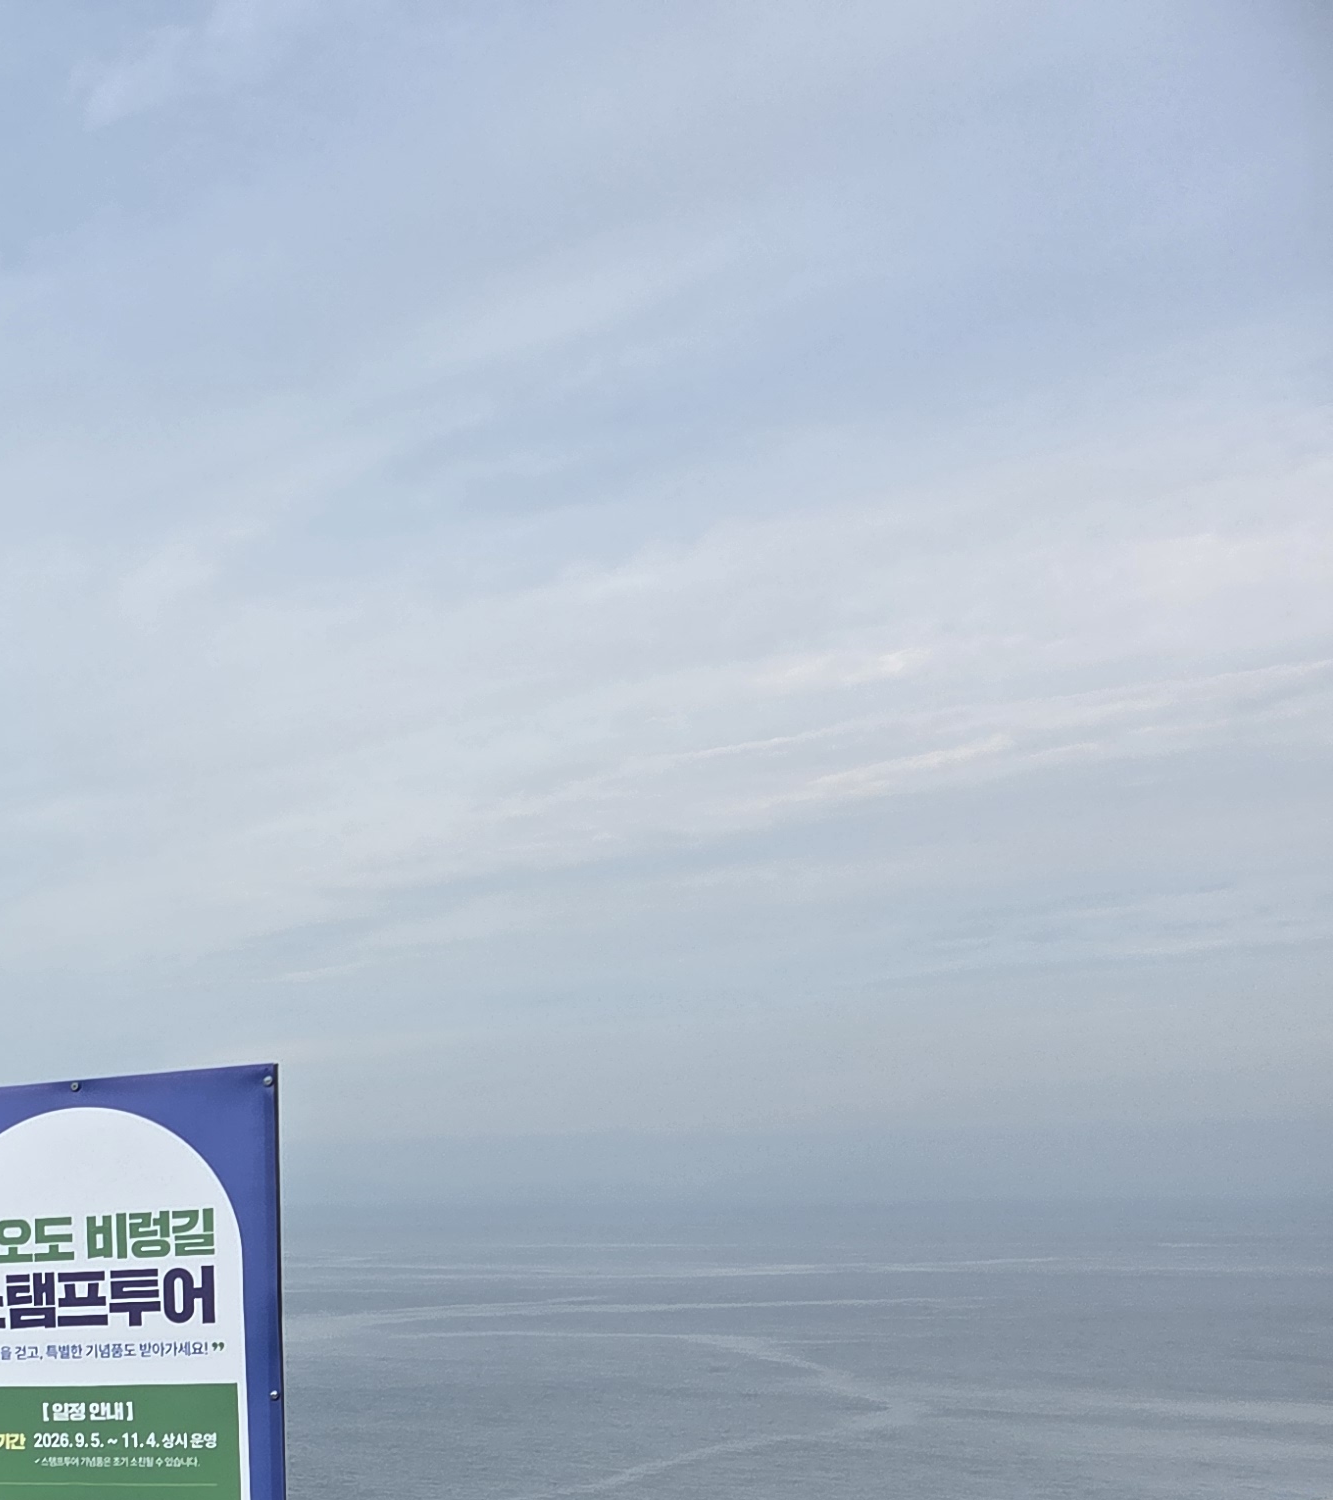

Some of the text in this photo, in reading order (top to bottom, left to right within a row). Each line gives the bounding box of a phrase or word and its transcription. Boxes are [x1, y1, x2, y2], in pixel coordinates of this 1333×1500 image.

[86, 1208, 215, 1259] 비렁길
[15, 1345, 43, 1360] 걷고,
[45, 1344, 83, 1359] 특별한
[85, 1342, 135, 1358] 기념품도
[52, 1402, 85, 1421] 일정
[89, 1402, 124, 1421] 안내
[162, 1433, 187, 1449] 상시
[190, 1433, 217, 1449] 운영
